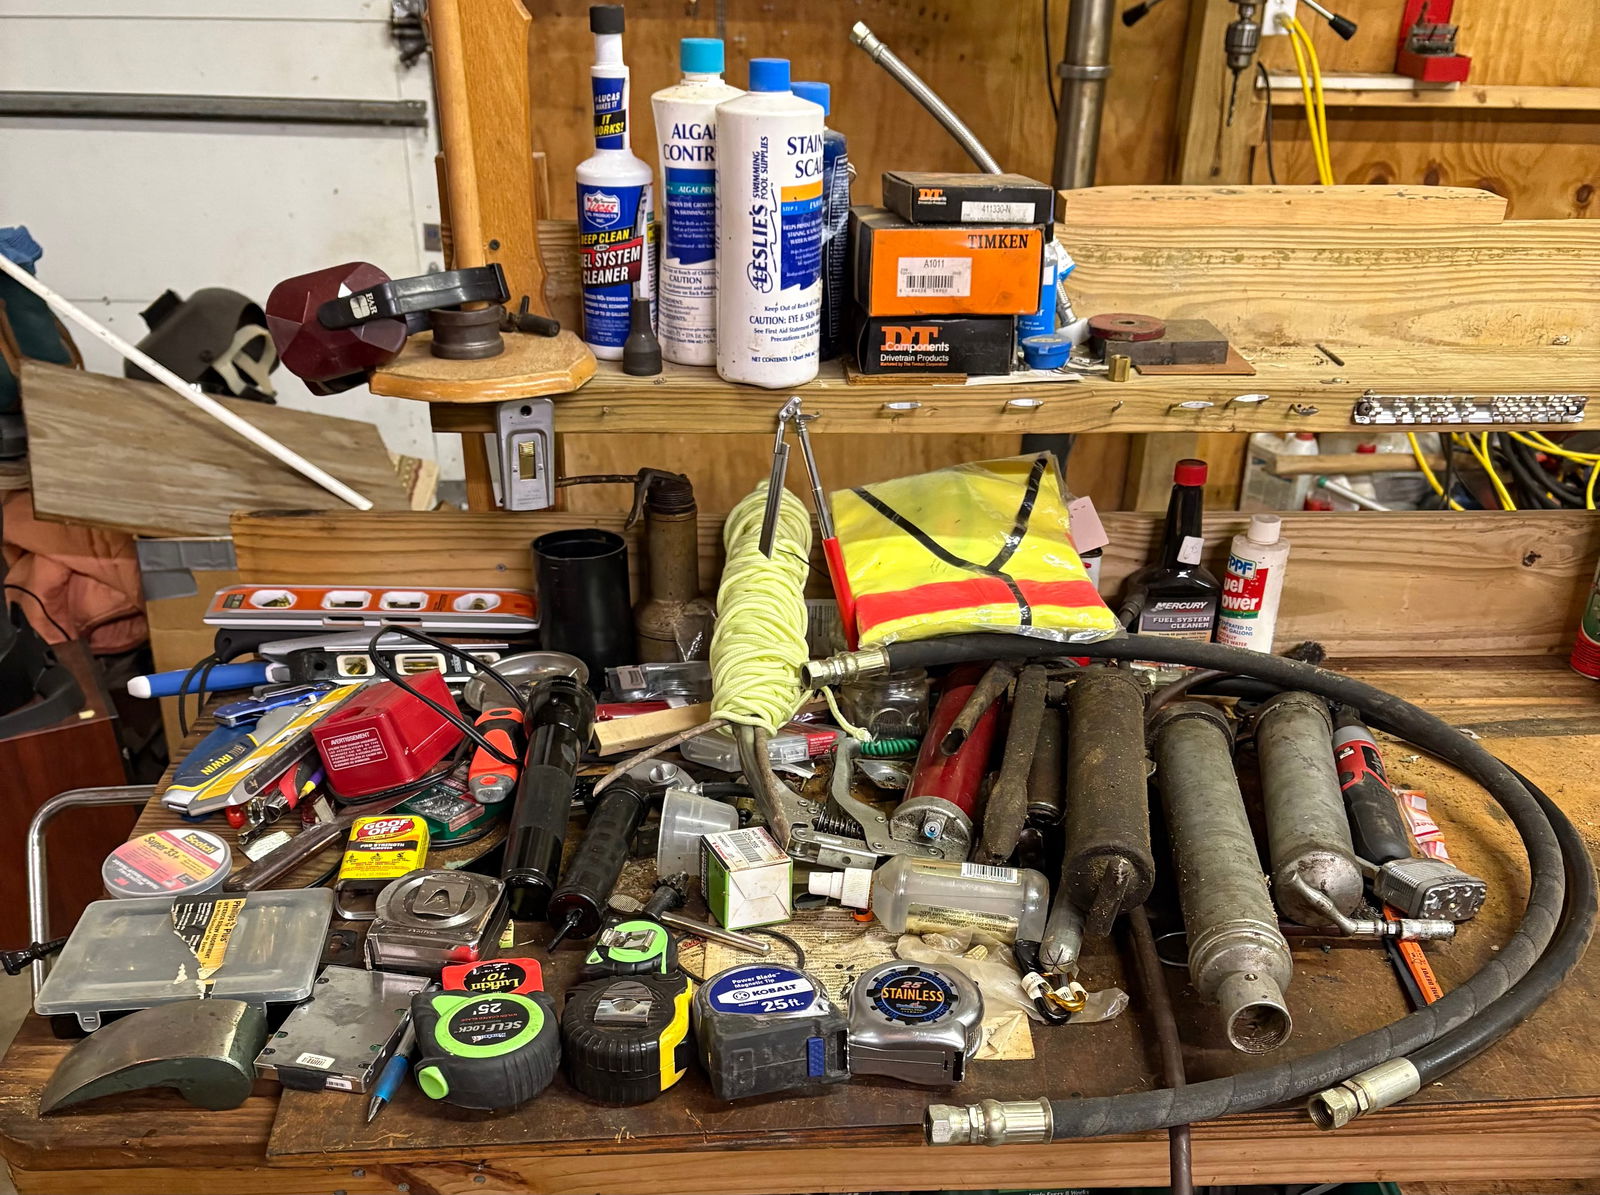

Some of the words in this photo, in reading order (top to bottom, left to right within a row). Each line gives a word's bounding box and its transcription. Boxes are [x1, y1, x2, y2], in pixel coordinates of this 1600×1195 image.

[599, 92, 620, 102] LUCAS
[602, 114, 611, 125] IT
[760, 136, 768, 174] SUPPLIES
[752, 151, 760, 199] SWIMMING
[760, 177, 768, 200] POOL
[982, 204, 1011, 213] 411330-N
[599, 229, 630, 243] CLEAN
[968, 233, 1029, 249] TIMKEN
[595, 246, 641, 268] SYSTEM
[924, 260, 944, 268] A1011
[583, 266, 629, 285] CLEANER
[669, 275, 702, 284] CAUTION
[749, 315, 786, 325] CAUTION:
[788, 315, 799, 323] EYE
[881, 326, 939, 351] DT
[886, 341, 950, 353] Components
[880, 354, 915, 362] Drivetrain
[917, 354, 949, 362] Products
[1228, 555, 1253, 575] PPF
[1223, 577, 1245, 594] uel
[1155, 601, 1208, 610] MERCURY
[1221, 594, 1260, 611] ower
[331, 732, 370, 745] AVERTISSEMENT
[200, 753, 234, 776] IRWIN
[363, 818, 411, 830] GOOF
[368, 826, 401, 836] OFF
[145, 836, 168, 852] Super
[164, 848, 179, 859] 33+
[185, 834, 216, 854] Scotch
[482, 972, 507, 982] 10'
[471, 978, 520, 992] Lufkin
[734, 981, 764, 989] Magnetic
[752, 984, 796, 996] KOBALT
[901, 981, 928, 989] 25'
[881, 988, 944, 1002] STAINLESS
[472, 1002, 502, 1016] 25'
[458, 1024, 486, 1033] LOCK
[486, 1020, 523, 1032] SELF
